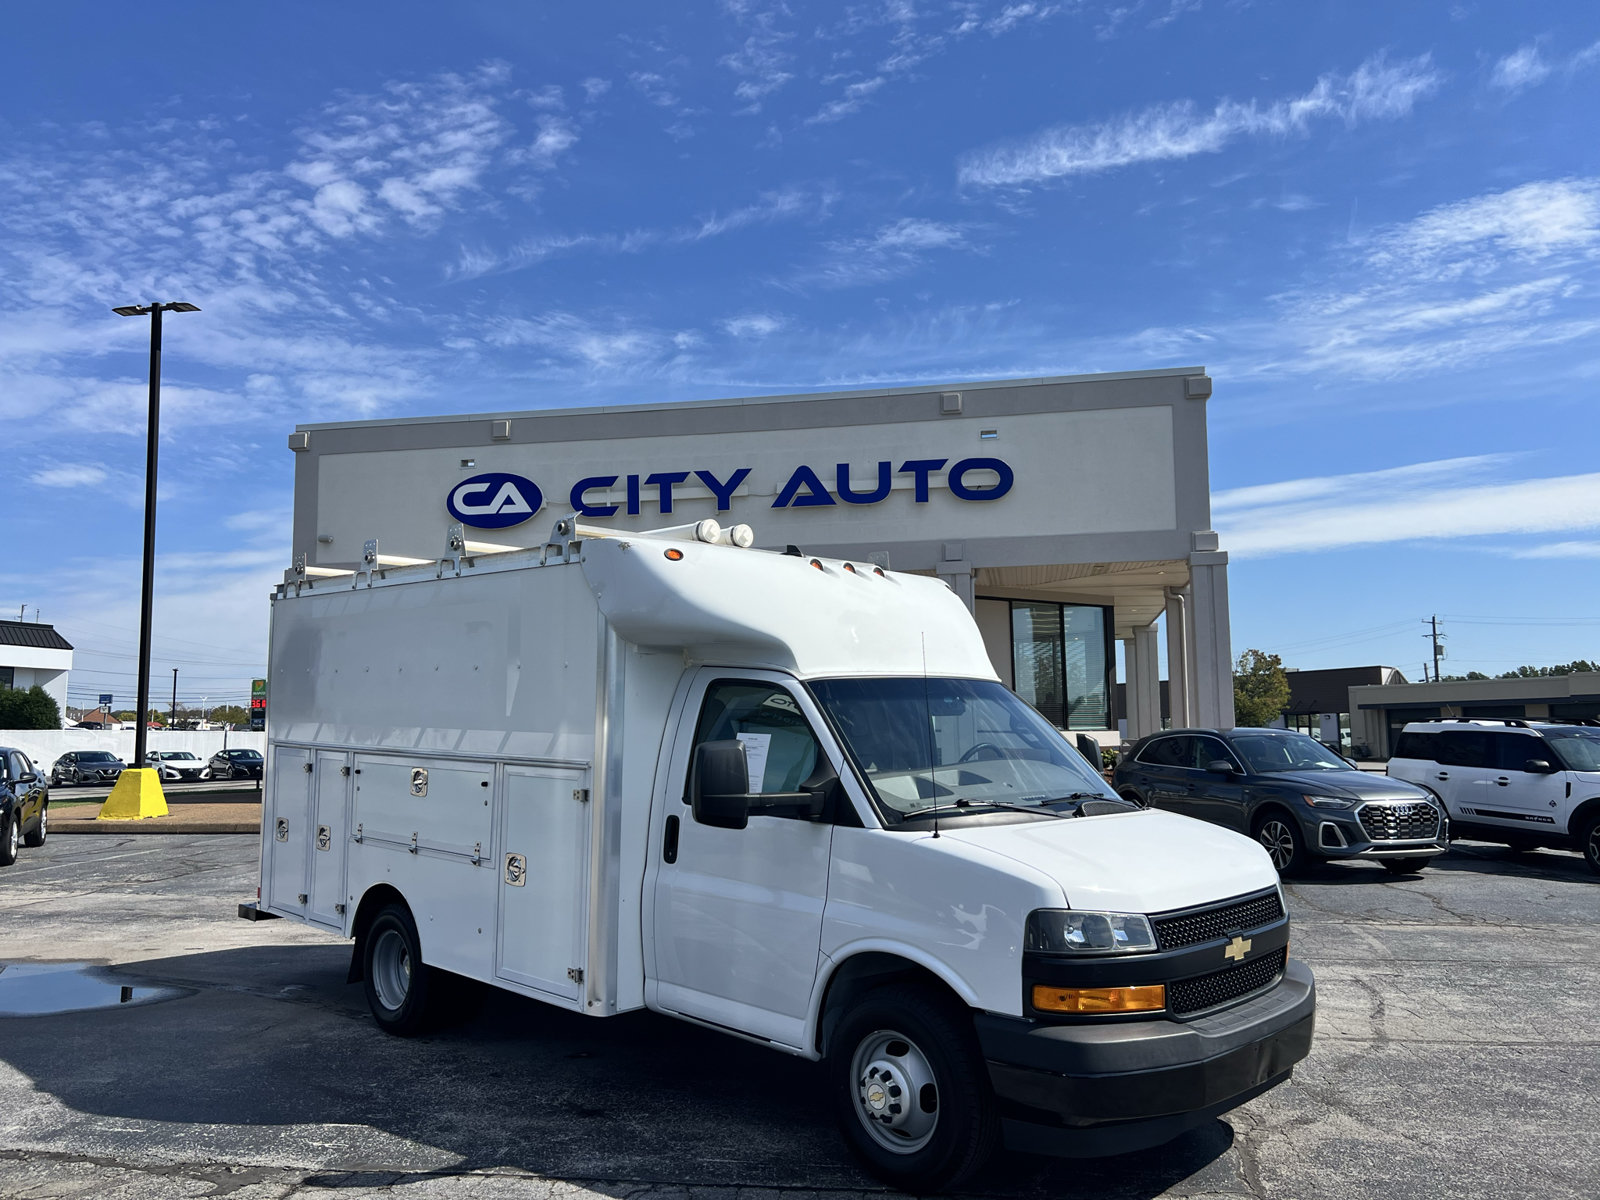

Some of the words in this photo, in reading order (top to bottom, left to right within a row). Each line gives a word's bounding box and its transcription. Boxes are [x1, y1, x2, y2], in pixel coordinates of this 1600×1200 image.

[453, 481, 533, 515] CA
[570, 468, 752, 517] CITY
[771, 457, 1014, 508] AUTO
